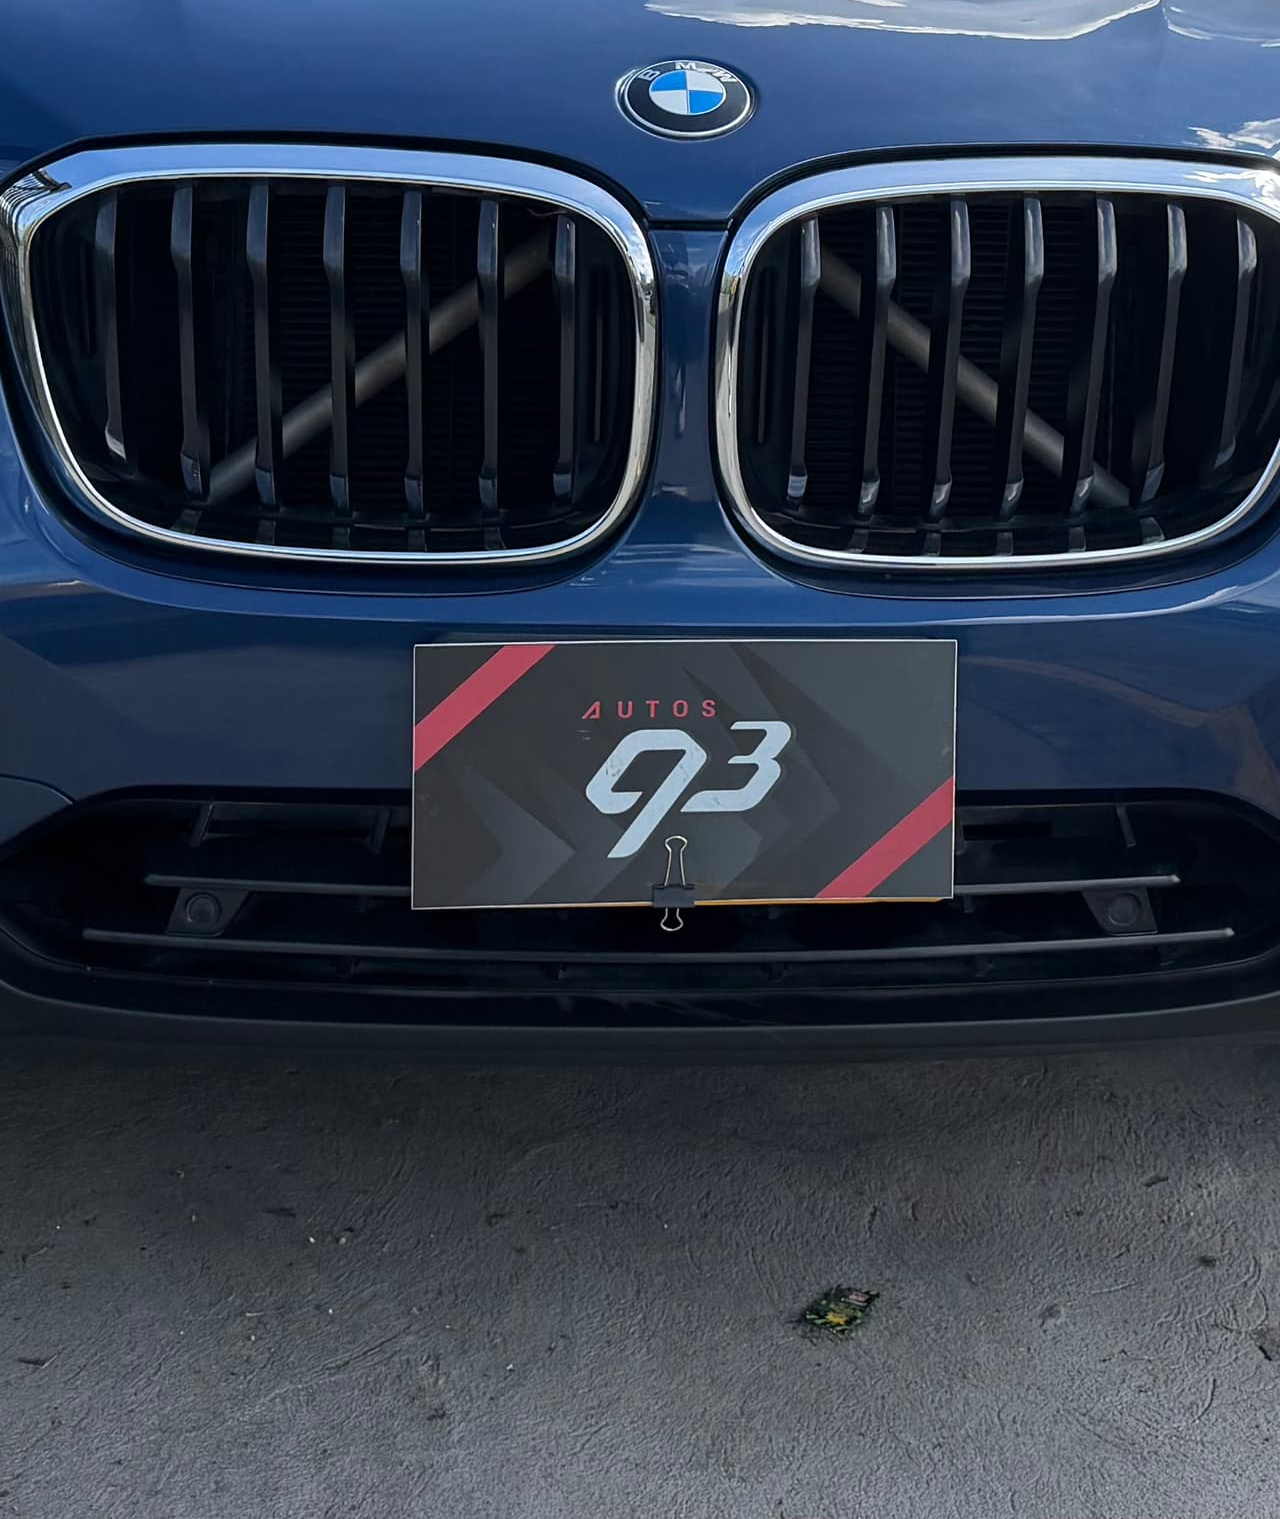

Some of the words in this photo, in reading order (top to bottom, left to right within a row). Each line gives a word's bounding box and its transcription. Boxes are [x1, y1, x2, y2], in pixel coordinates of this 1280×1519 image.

[637, 61, 738, 83] BMW
[581, 699, 717, 720] AUTOS
[585, 720, 792, 858] 93
